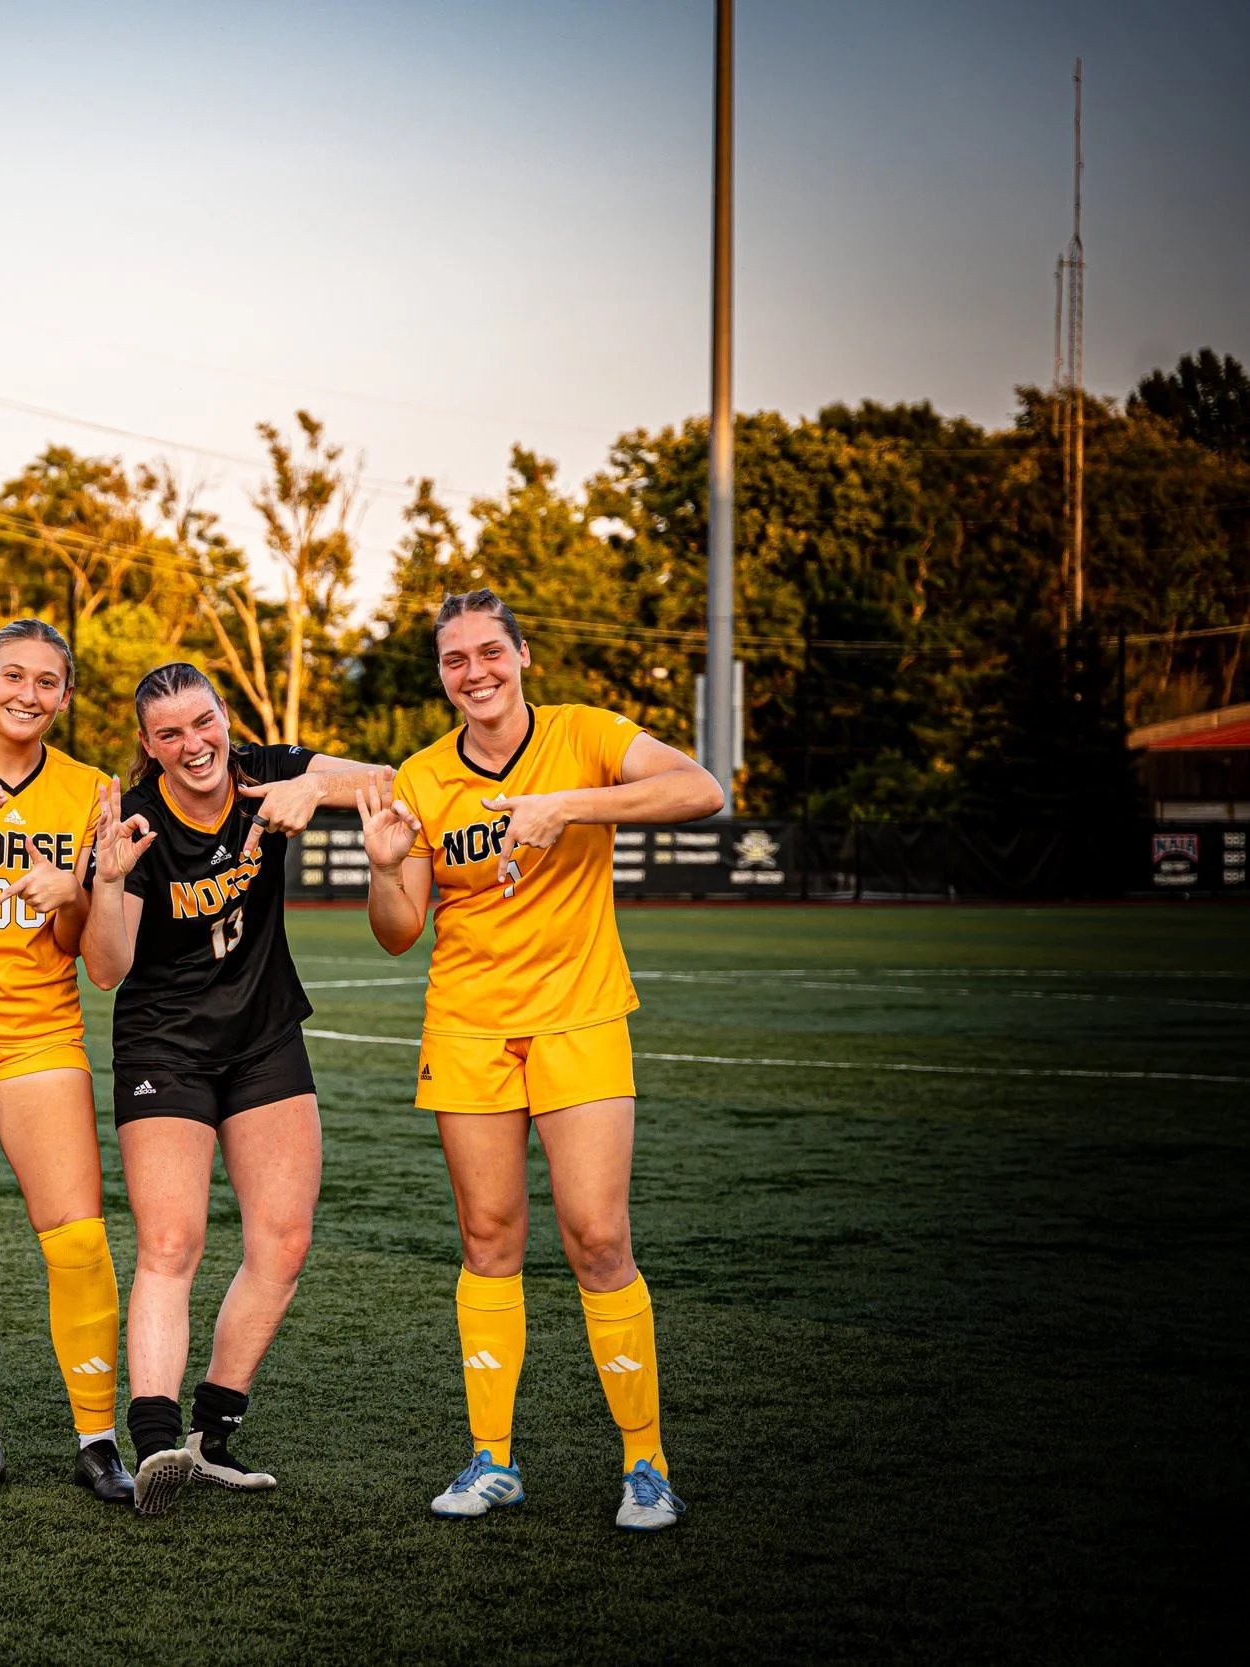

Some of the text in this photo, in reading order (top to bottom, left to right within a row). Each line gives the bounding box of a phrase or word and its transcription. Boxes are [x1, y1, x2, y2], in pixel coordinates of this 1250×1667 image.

[442, 813, 520, 866] NOR
[211, 852, 232, 865] adidas
[133, 1088, 157, 1096] adidas
